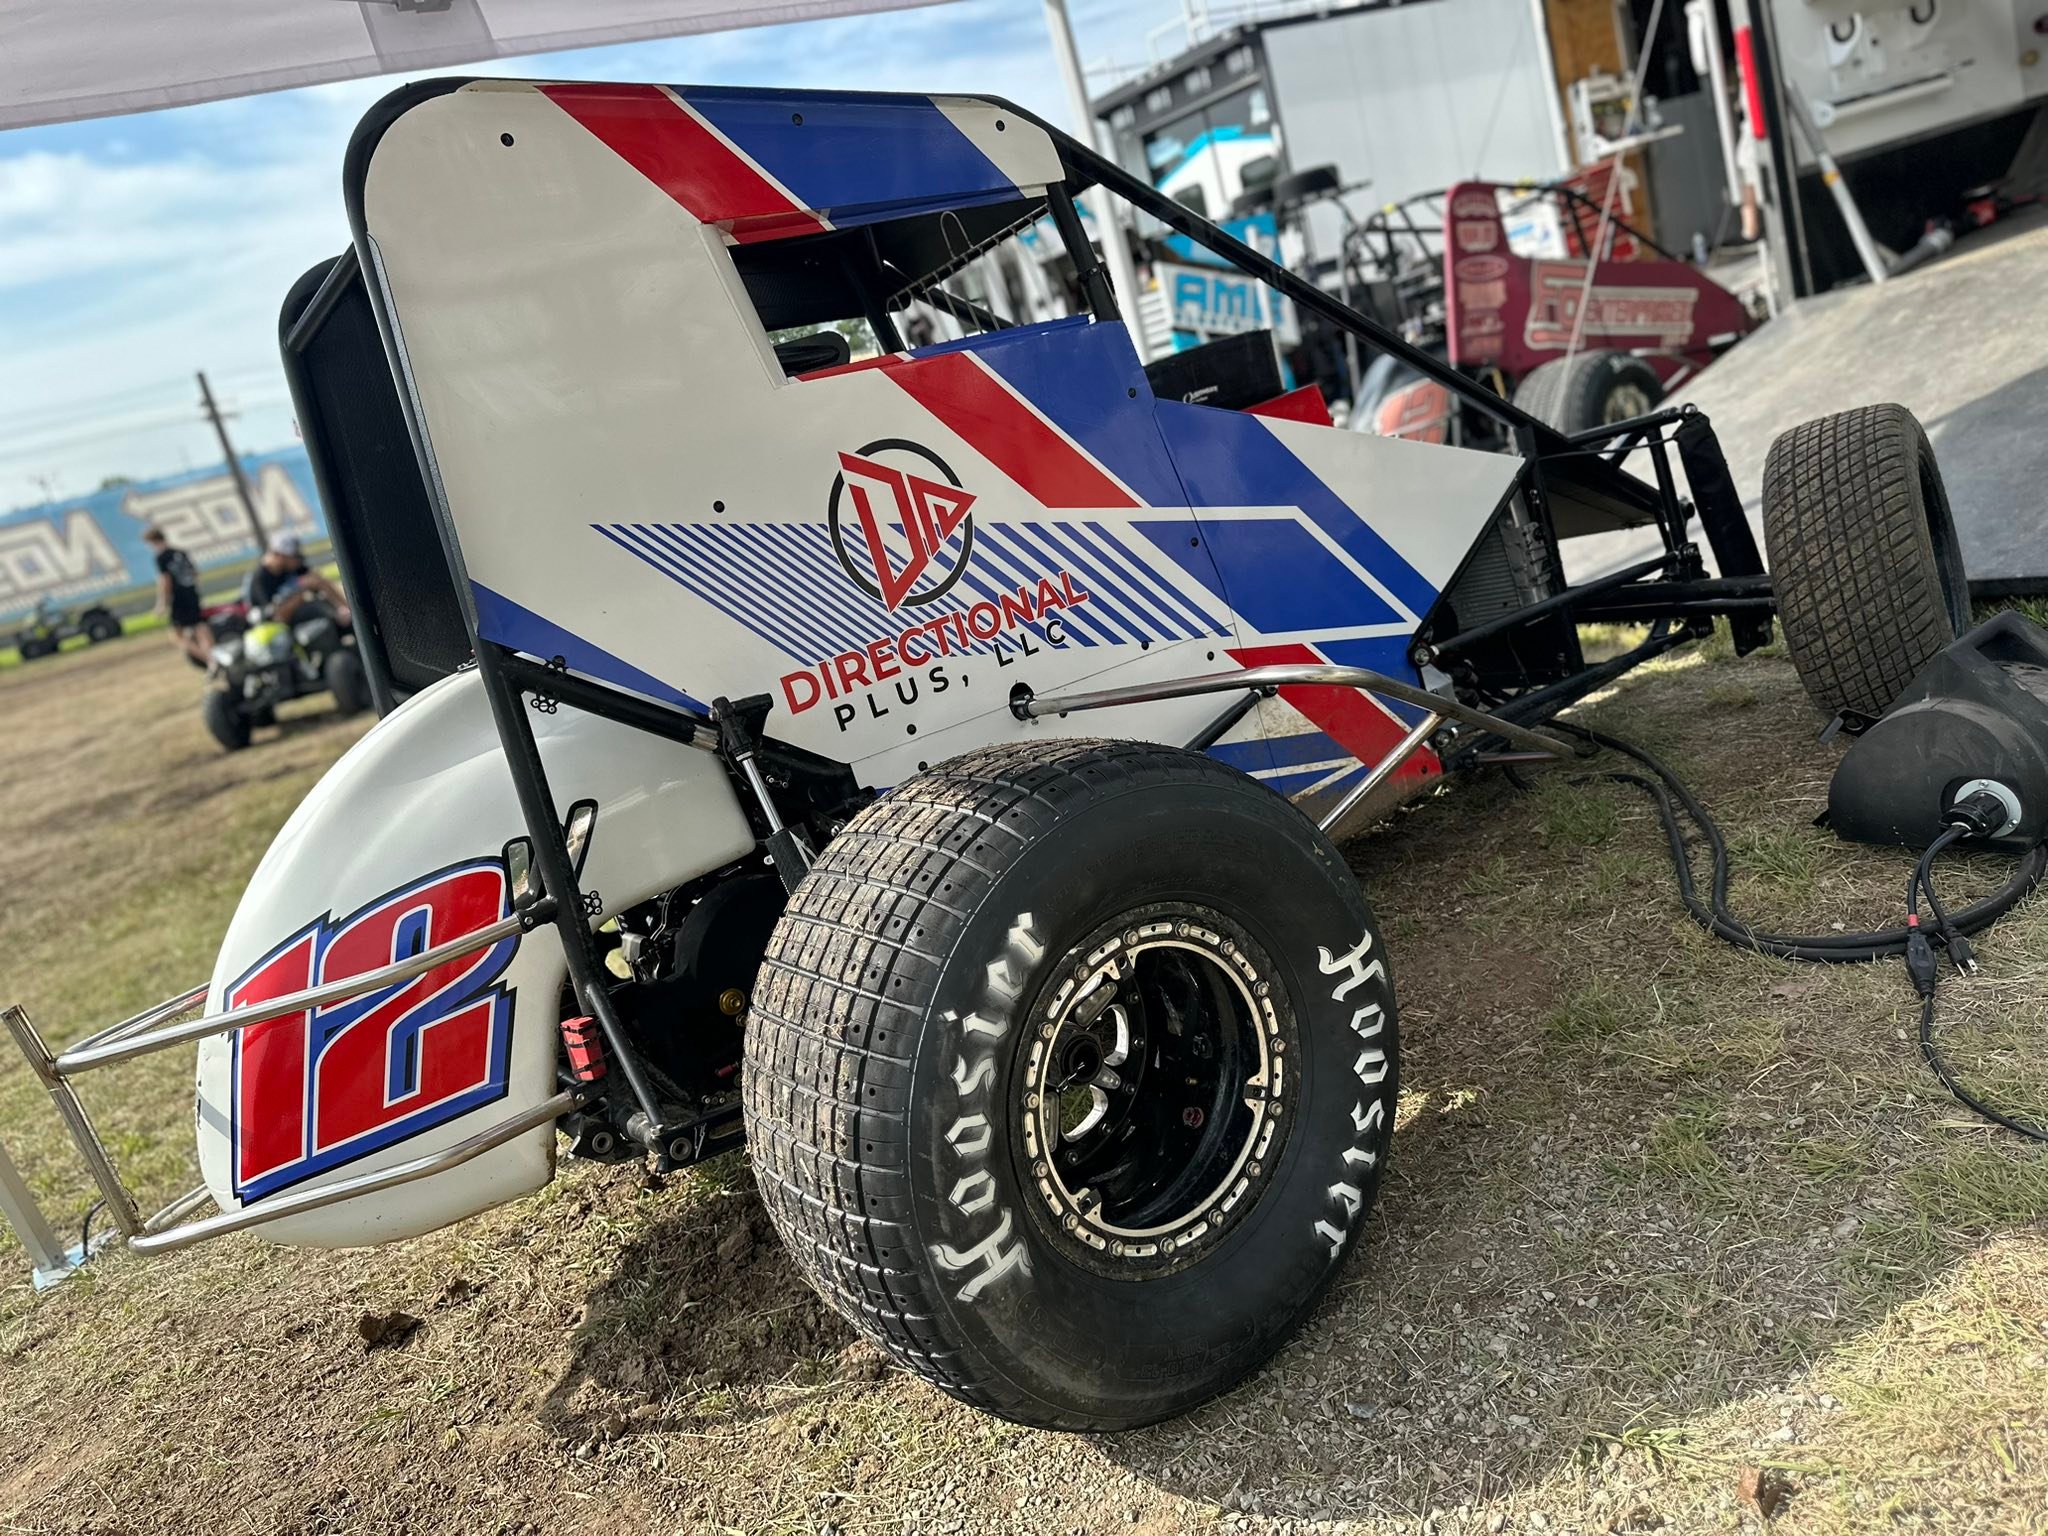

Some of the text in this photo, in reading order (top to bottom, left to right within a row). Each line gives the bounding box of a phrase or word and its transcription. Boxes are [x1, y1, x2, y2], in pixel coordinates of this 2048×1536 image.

[779, 570, 1089, 715] DIRECTIONAL
[834, 619, 1066, 731] PLUS, LLC
[225, 855, 518, 1207] 12
[931, 912, 1046, 1300] Hoosier
[1314, 929, 1388, 1260] Hoosier
